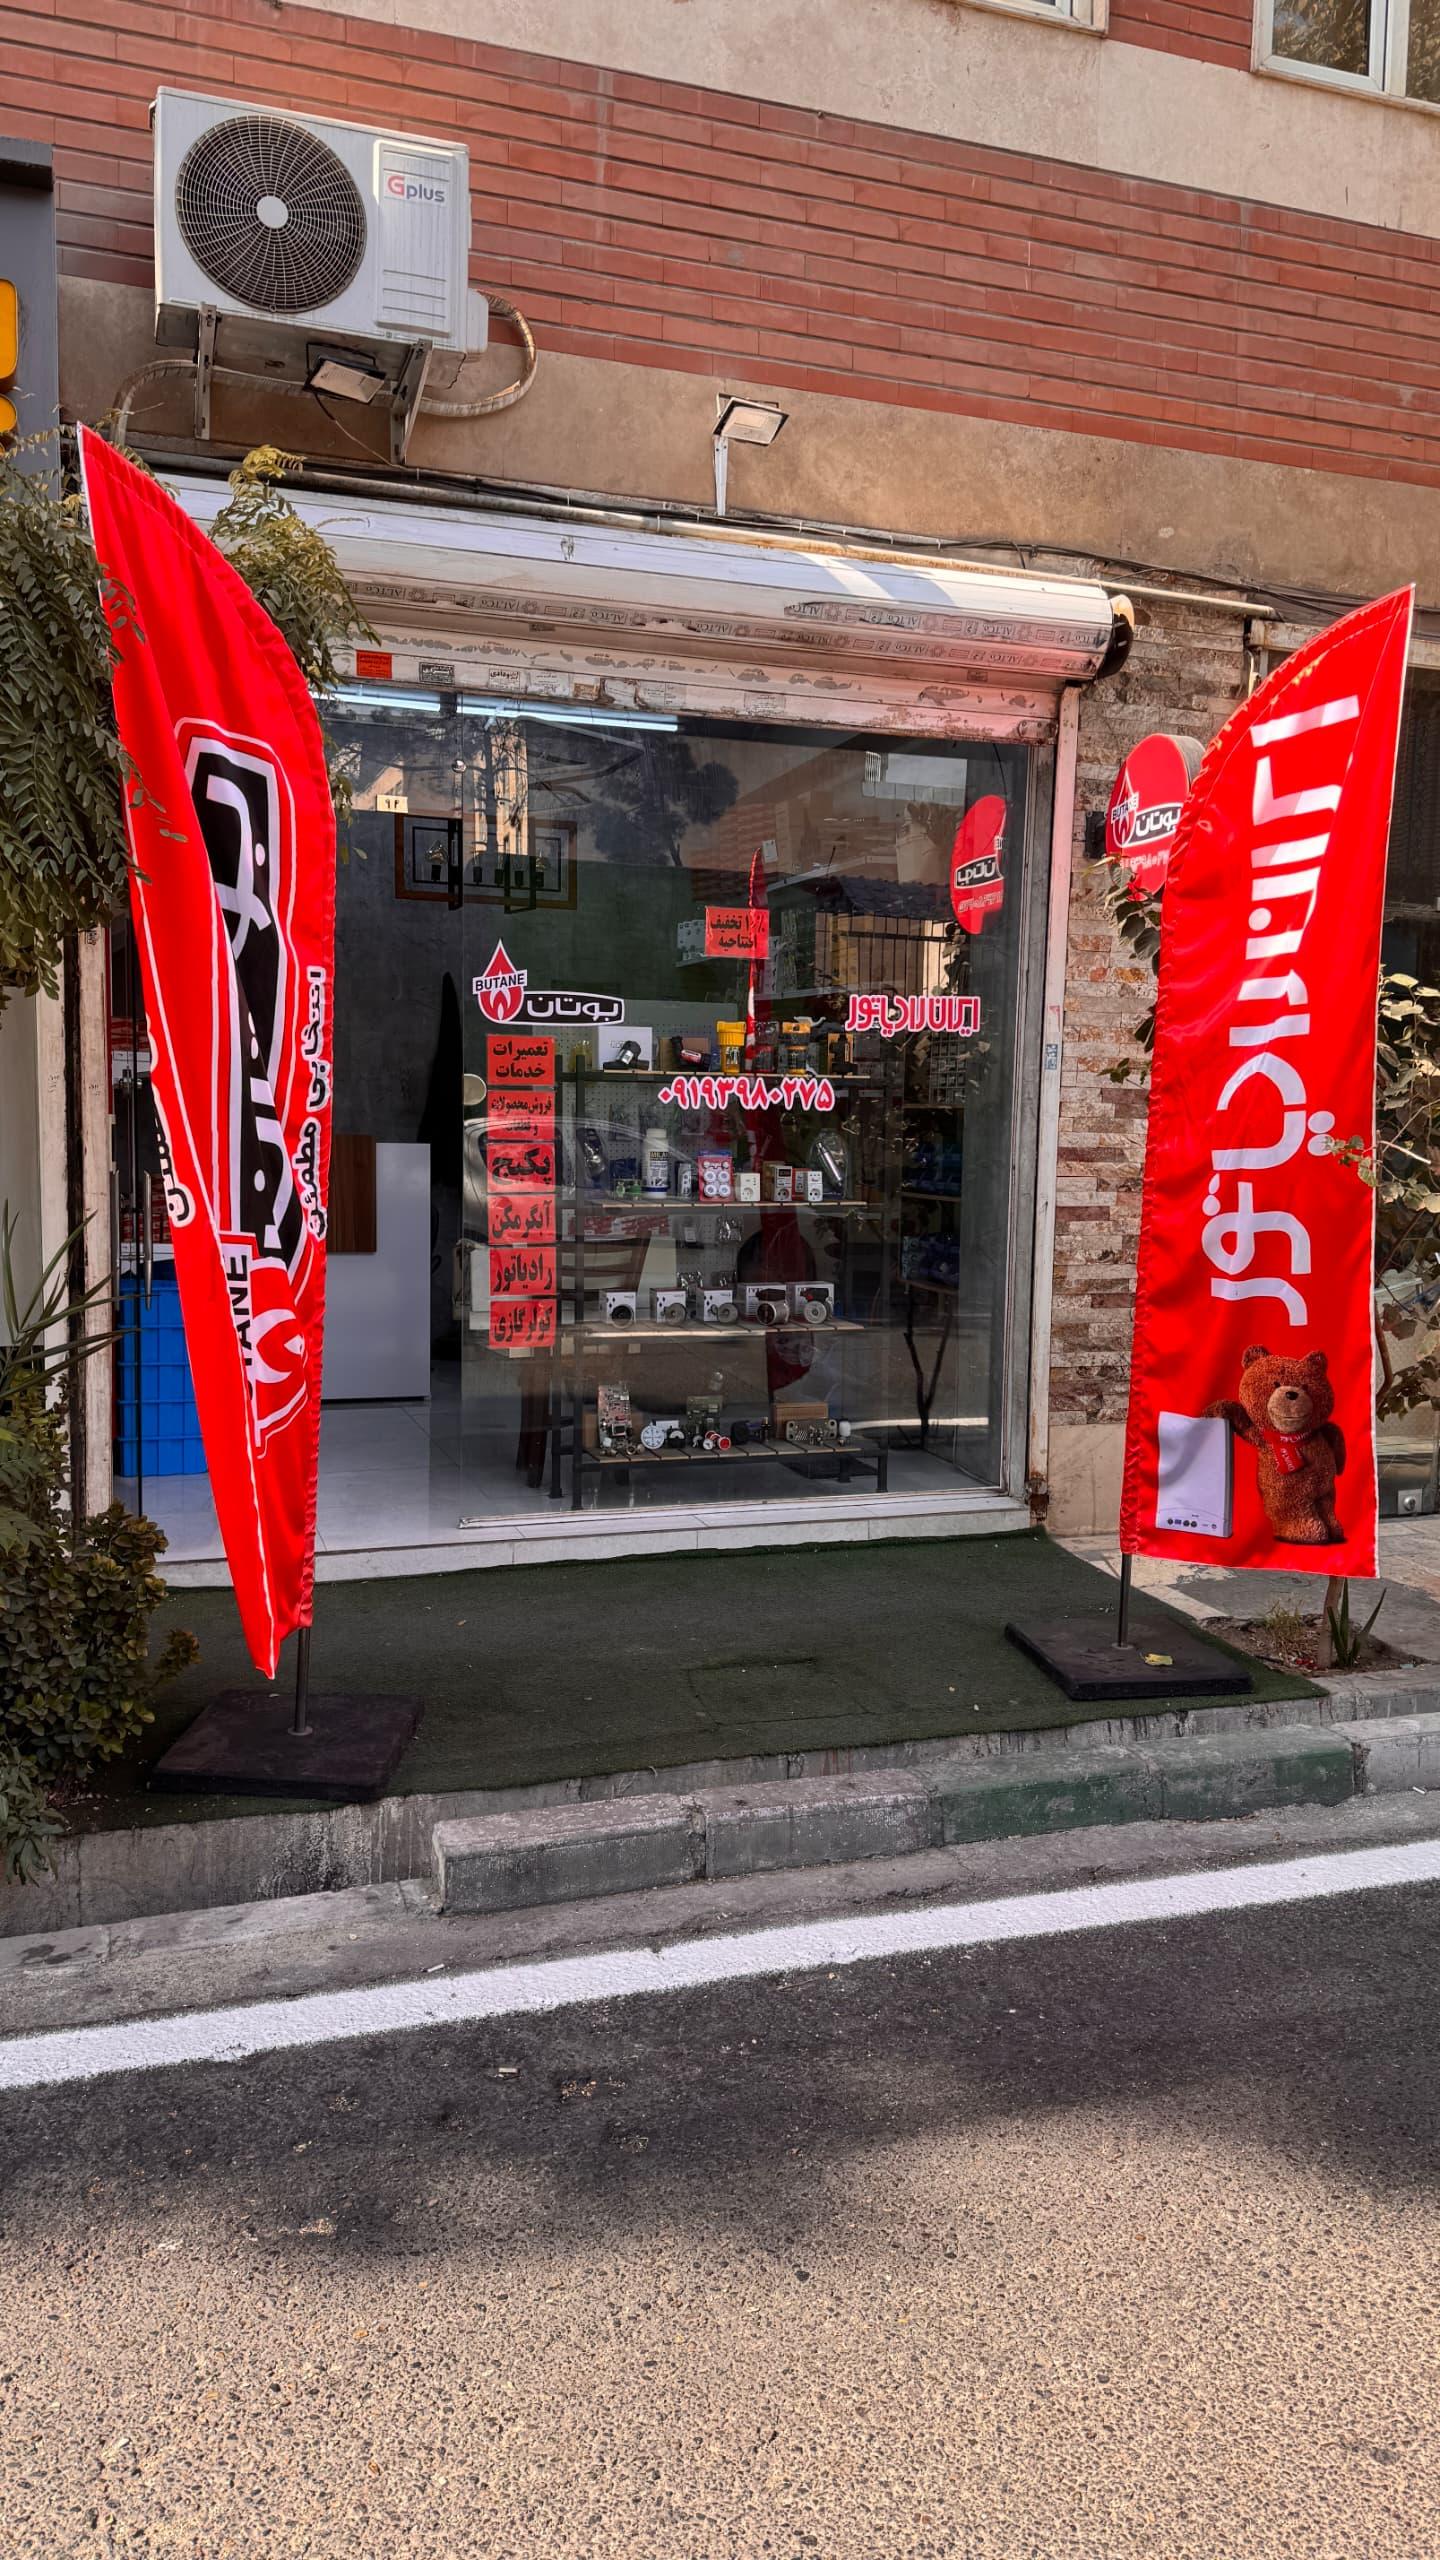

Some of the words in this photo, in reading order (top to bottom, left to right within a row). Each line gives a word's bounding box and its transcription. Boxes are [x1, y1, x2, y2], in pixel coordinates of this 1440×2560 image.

[387, 174, 446, 203] Gplus
[710, 914, 742, 933] تخفیف
[475, 972, 526, 992] BUTANE
[526, 996, 620, 1023] بوتان
[845, 995, 927, 1037] رادیاتور
[929, 996, 981, 1036] ایران
[493, 1040, 549, 1061] تعمیرات
[495, 1062, 546, 1078] خدمات
[528, 1095, 553, 1115] فروش
[657, 1075, 836, 1112] ۰۹۱۹۳۹۸۰۲۷۵
[492, 1147, 552, 1186] پکیج
[493, 1251, 553, 1293] رادیاتور
